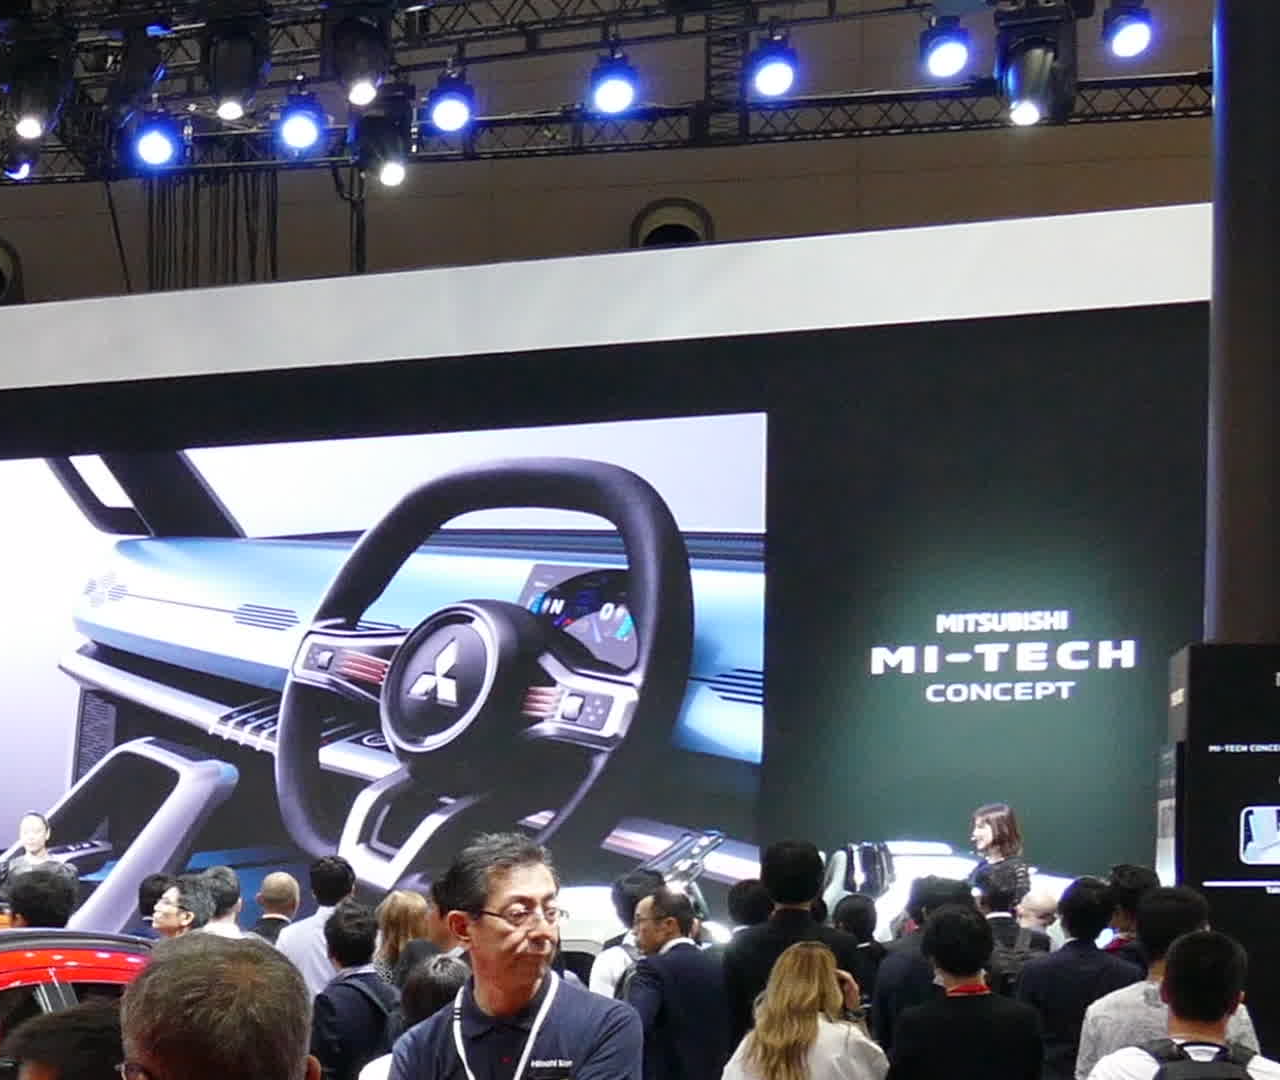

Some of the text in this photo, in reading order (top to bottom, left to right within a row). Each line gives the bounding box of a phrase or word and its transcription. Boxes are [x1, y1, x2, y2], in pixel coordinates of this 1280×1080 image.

[936, 610, 1069, 633] MITSUBISHI
[870, 640, 1137, 675] MI-TECH
[925, 681, 1076, 702] CONCEPT
